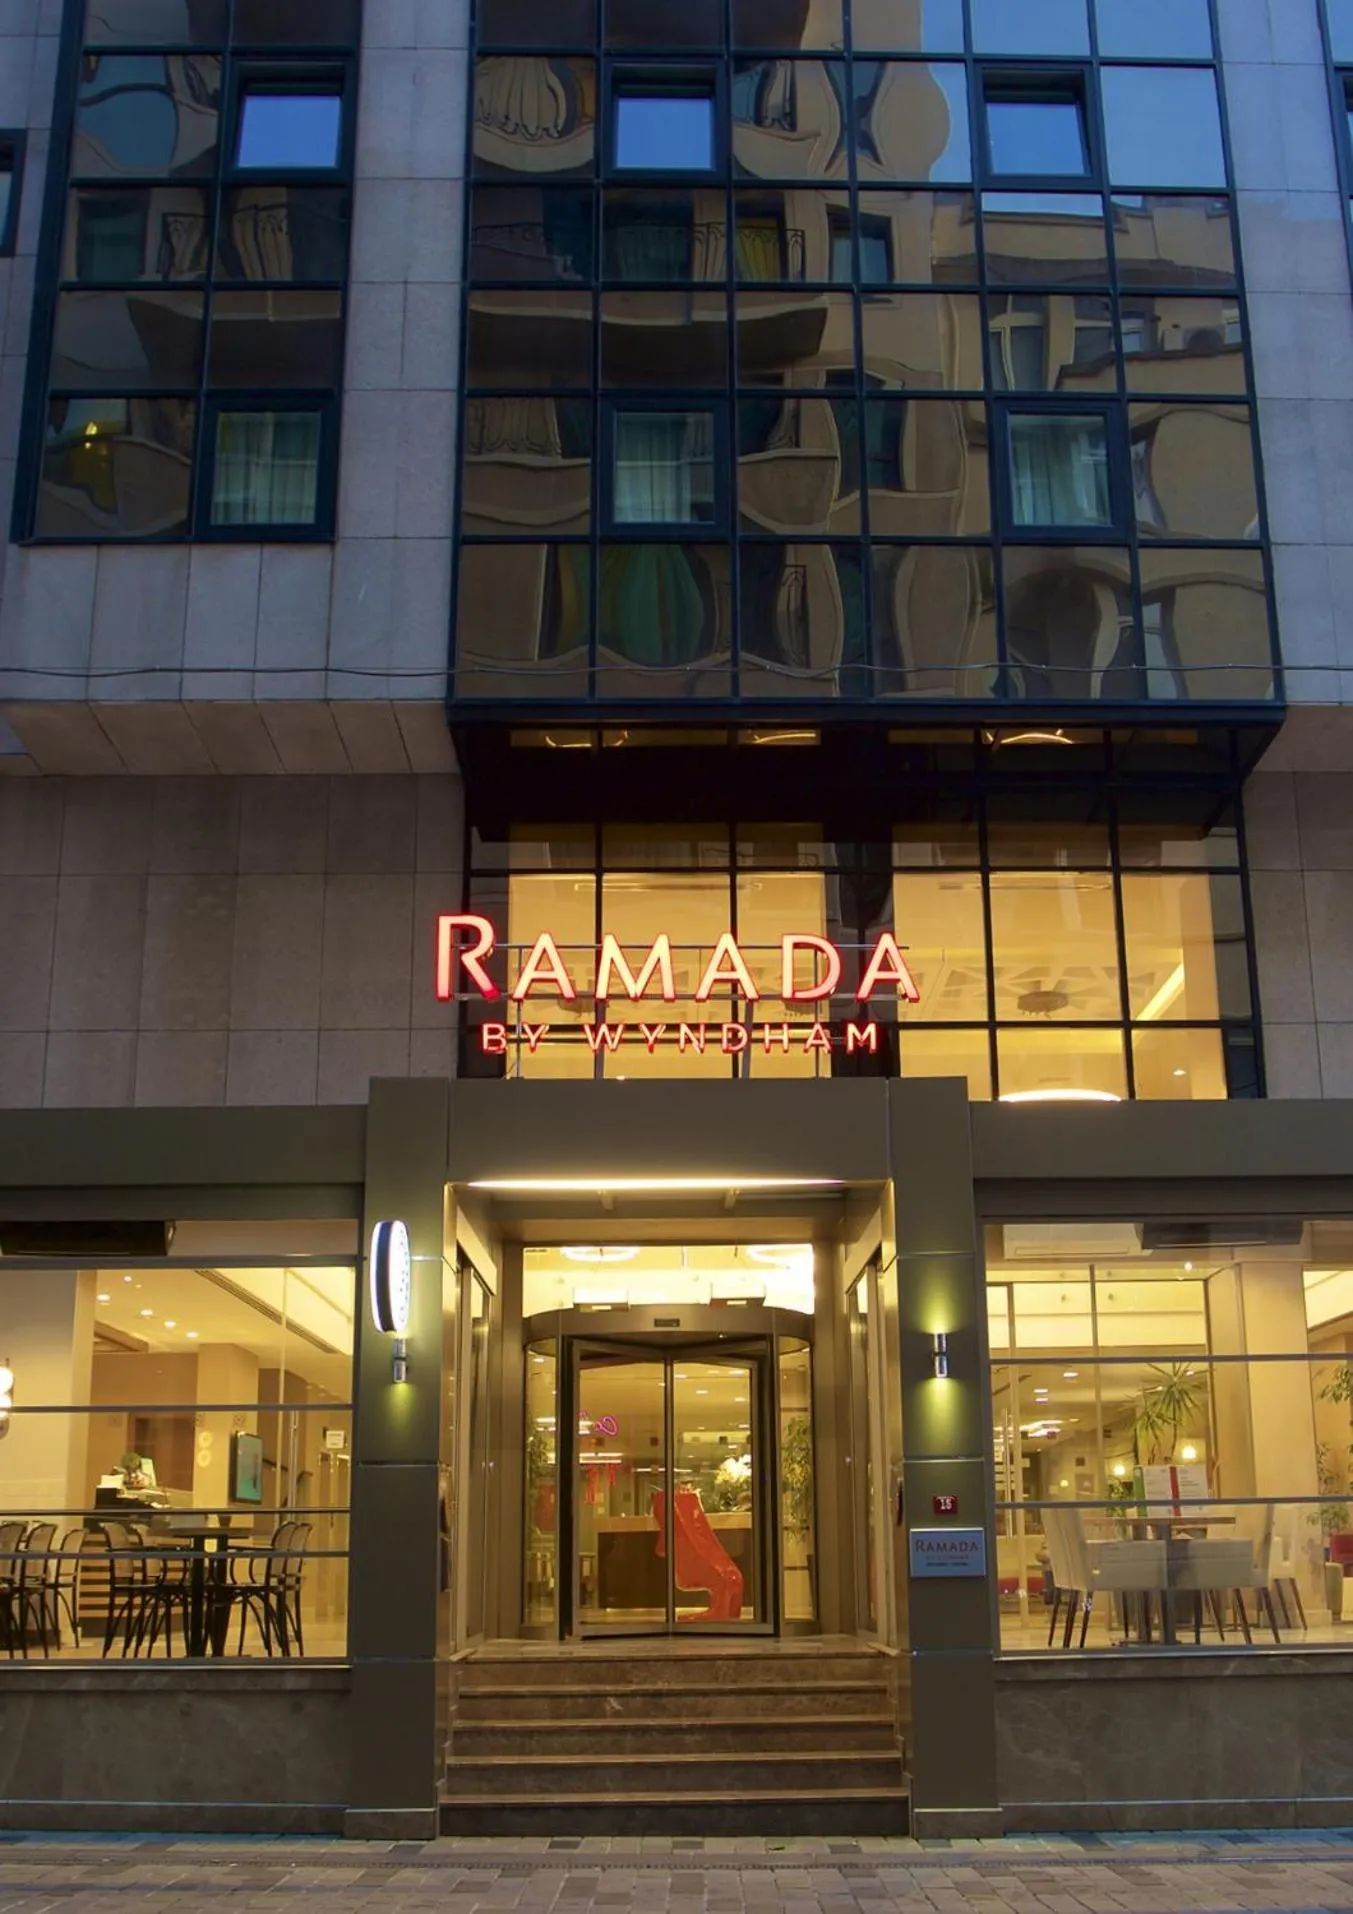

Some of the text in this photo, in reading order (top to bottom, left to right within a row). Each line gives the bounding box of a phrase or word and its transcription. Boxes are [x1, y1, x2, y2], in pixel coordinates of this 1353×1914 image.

[436, 914, 920, 1002] RAMADA
[481, 1022, 880, 1055] BY WYNDHAM
[915, 1540, 979, 1553] RAMADA
